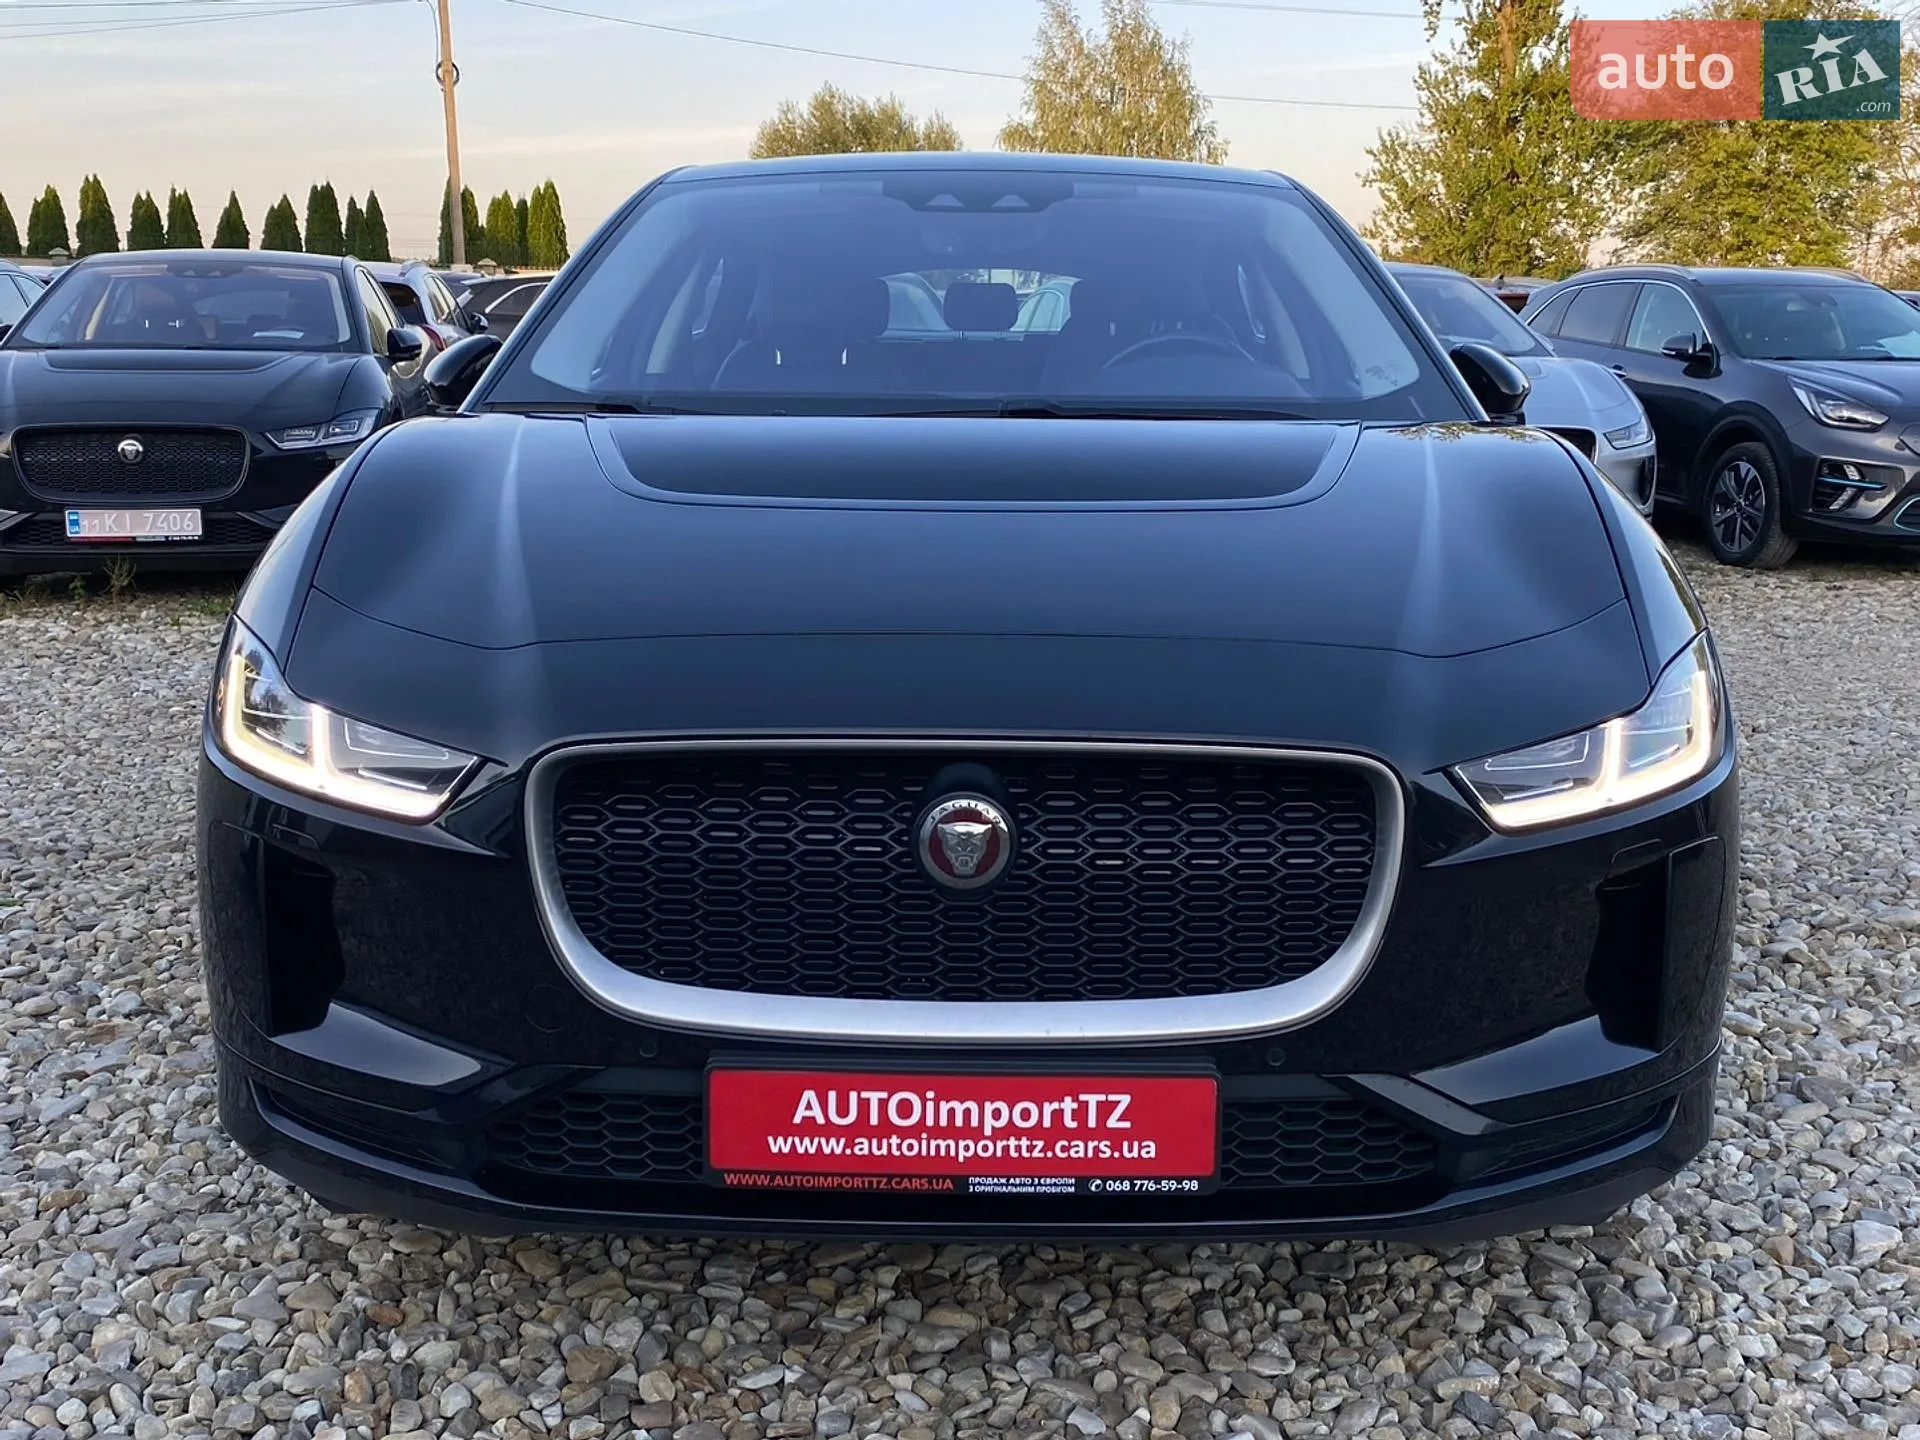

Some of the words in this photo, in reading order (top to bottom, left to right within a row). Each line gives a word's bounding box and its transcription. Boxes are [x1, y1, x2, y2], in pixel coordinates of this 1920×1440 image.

[143, 513, 194, 532] 7406
[793, 1089, 1132, 1135] AUTOimportTZ
[768, 1133, 1156, 1162] www.autoimporttz.cars.ua
[724, 1173, 954, 1190] WWW.AUTOIMPORTTZ.CARS.UA
[968, 1177, 1007, 1185] ПРОДАЖ
[1009, 1177, 1032, 1185] АВТО
[1106, 1180, 1131, 1191] 068
[1133, 1180, 1199, 1191] 776-59-98
